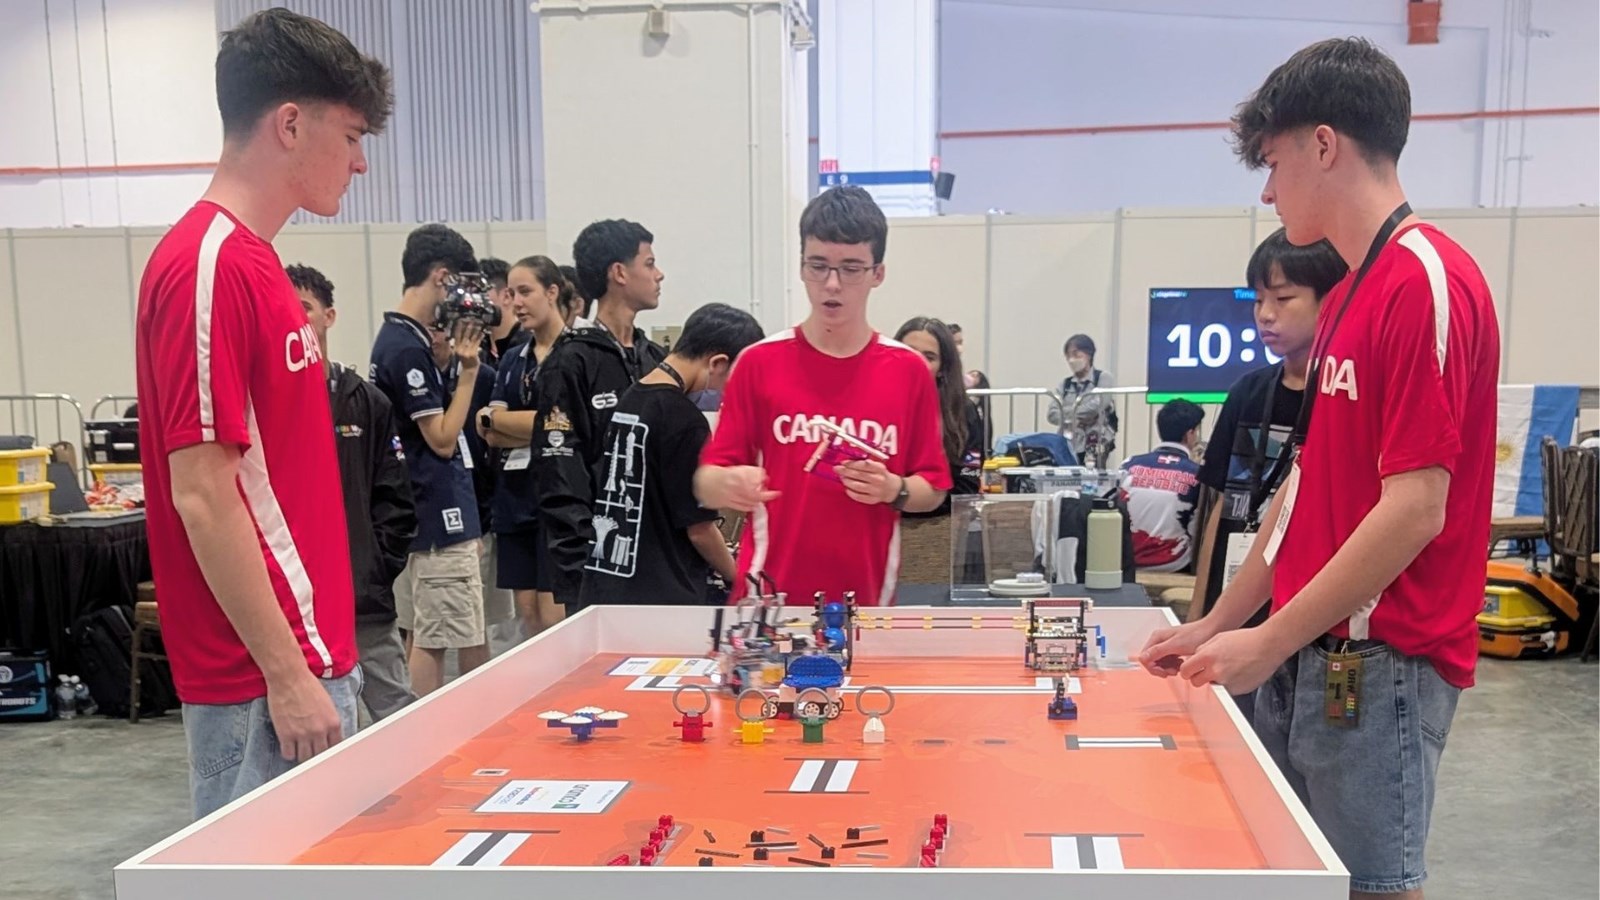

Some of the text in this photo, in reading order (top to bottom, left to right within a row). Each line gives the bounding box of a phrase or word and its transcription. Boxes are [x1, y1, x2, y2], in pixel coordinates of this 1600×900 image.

[1314, 355, 1358, 401] DA
[772, 413, 898, 456] CANADA
[1129, 465, 1199, 487] DOMINICAN
[1131, 476, 1189, 496] REPUBLIC
